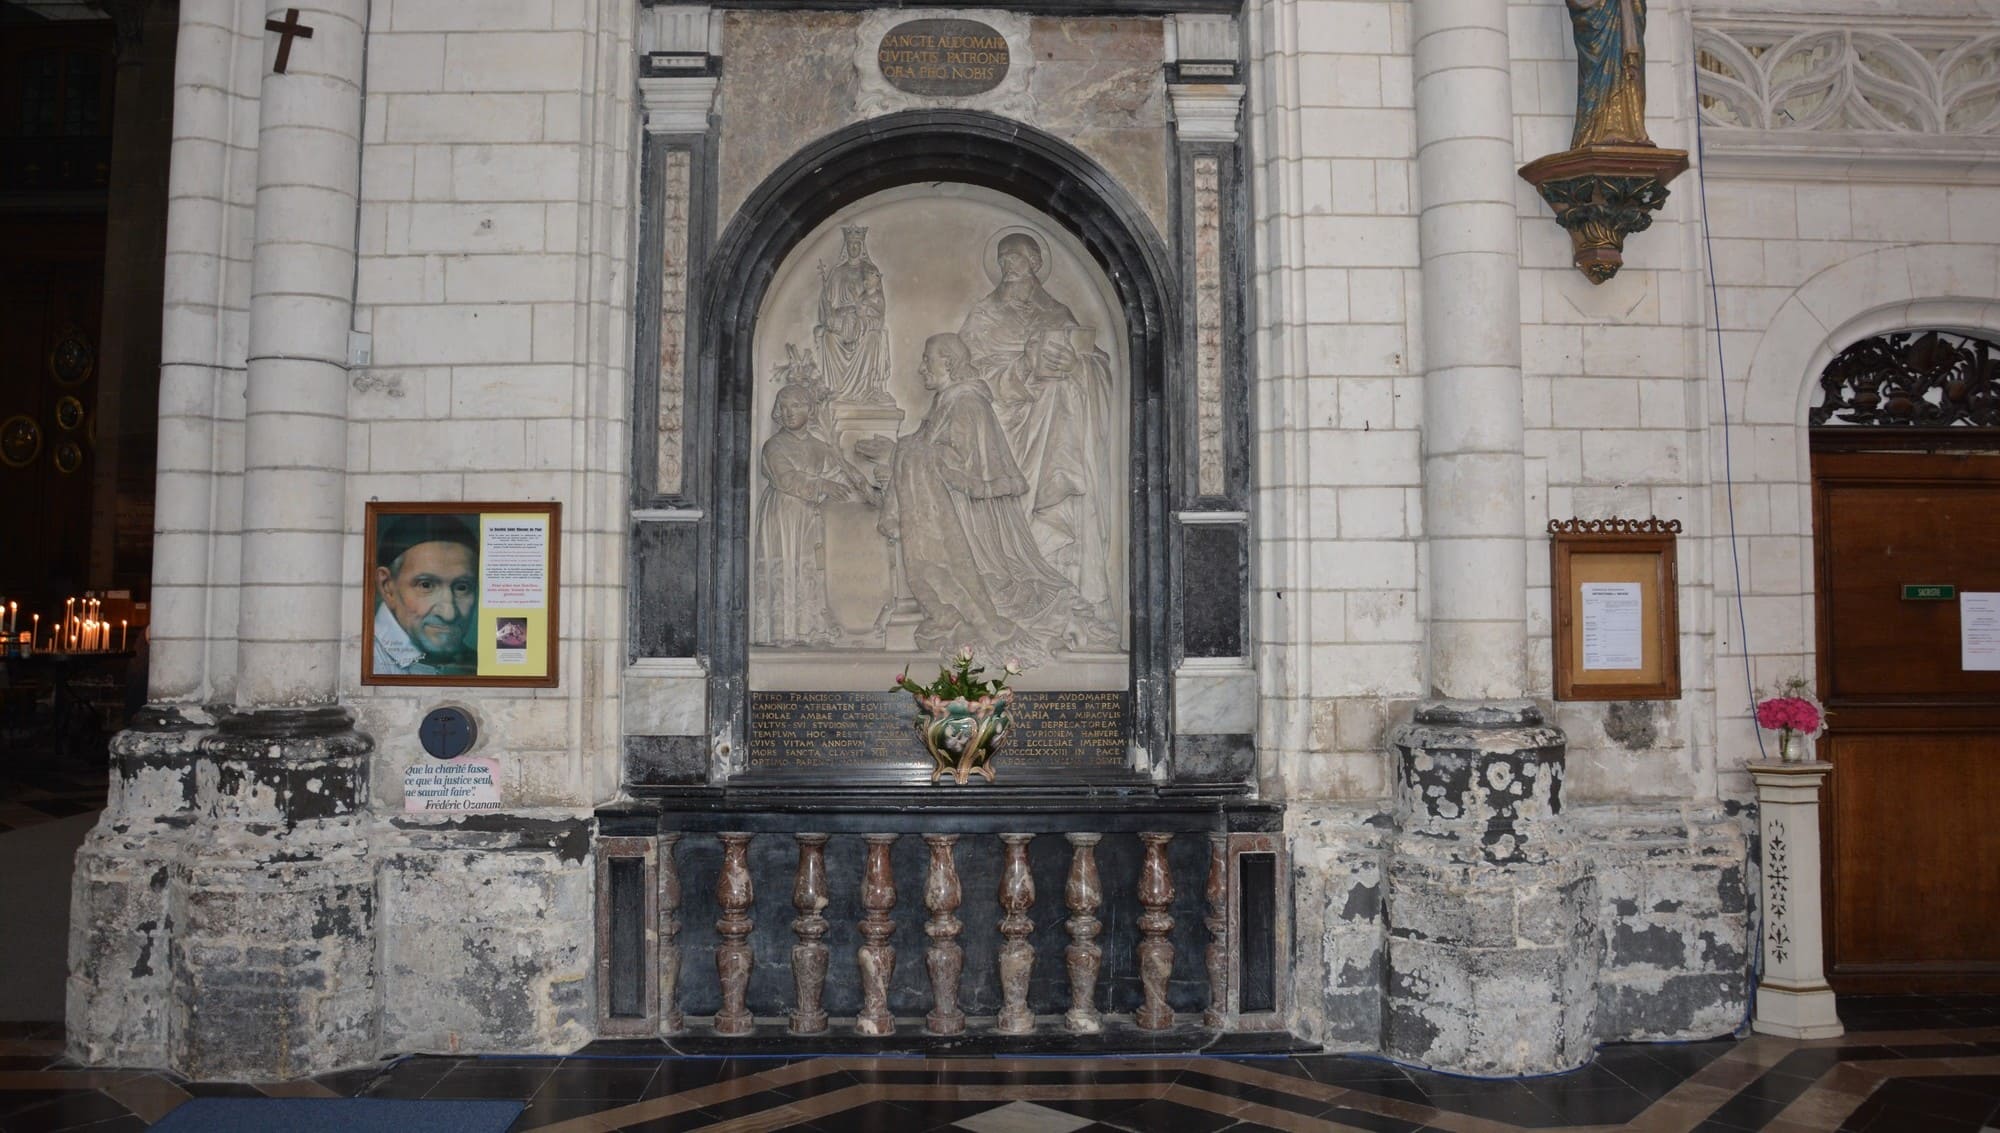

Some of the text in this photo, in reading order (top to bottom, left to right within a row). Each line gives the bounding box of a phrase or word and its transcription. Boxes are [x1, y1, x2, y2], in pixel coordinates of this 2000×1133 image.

[883, 35, 935, 48] SANCTE
[946, 51, 1008, 64] PATRONE
[885, 66, 994, 80] ORA PRO NOBIS
[790, 692, 842, 701] FRANCISCO
[1057, 693, 1120, 701] AVDOMAREN
[752, 703, 797, 711] CANONICO
[1033, 702, 1077, 710] PAVPERES
[1085, 702, 1120, 710] PATREM
[800, 712, 832, 720] AMBAE
[1012, 711, 1050, 719] MARIA
[752, 721, 786, 729] CVLTVS
[792, 721, 806, 729] SVI
[1014, 721, 1031, 729] NAE
[752, 730, 797, 738] TEMPLVM
[806, 730, 826, 738] HOC
[750, 739, 776, 747] CVIVS
[783, 739, 814, 747] VITAM
[821, 739, 865, 747] ANNORVM
[1026, 739, 1073, 747] ECCLESIAE
[751, 749, 777, 757] MORS
[785, 749, 821, 757] SANCTA
[1096, 748, 1120, 756] PACE
[405, 765, 424, 777] Que
[425, 764, 433, 773] la
[435, 763, 466, 774] charité
[404, 777, 414, 785] ce
[415, 777, 433, 787] que
[433, 775, 443, 785] la
[443, 774, 472, 787] justice
[405, 788, 416, 797] ne
[417, 787, 449, 797] saurait
[425, 799, 462, 810] Frédéric
